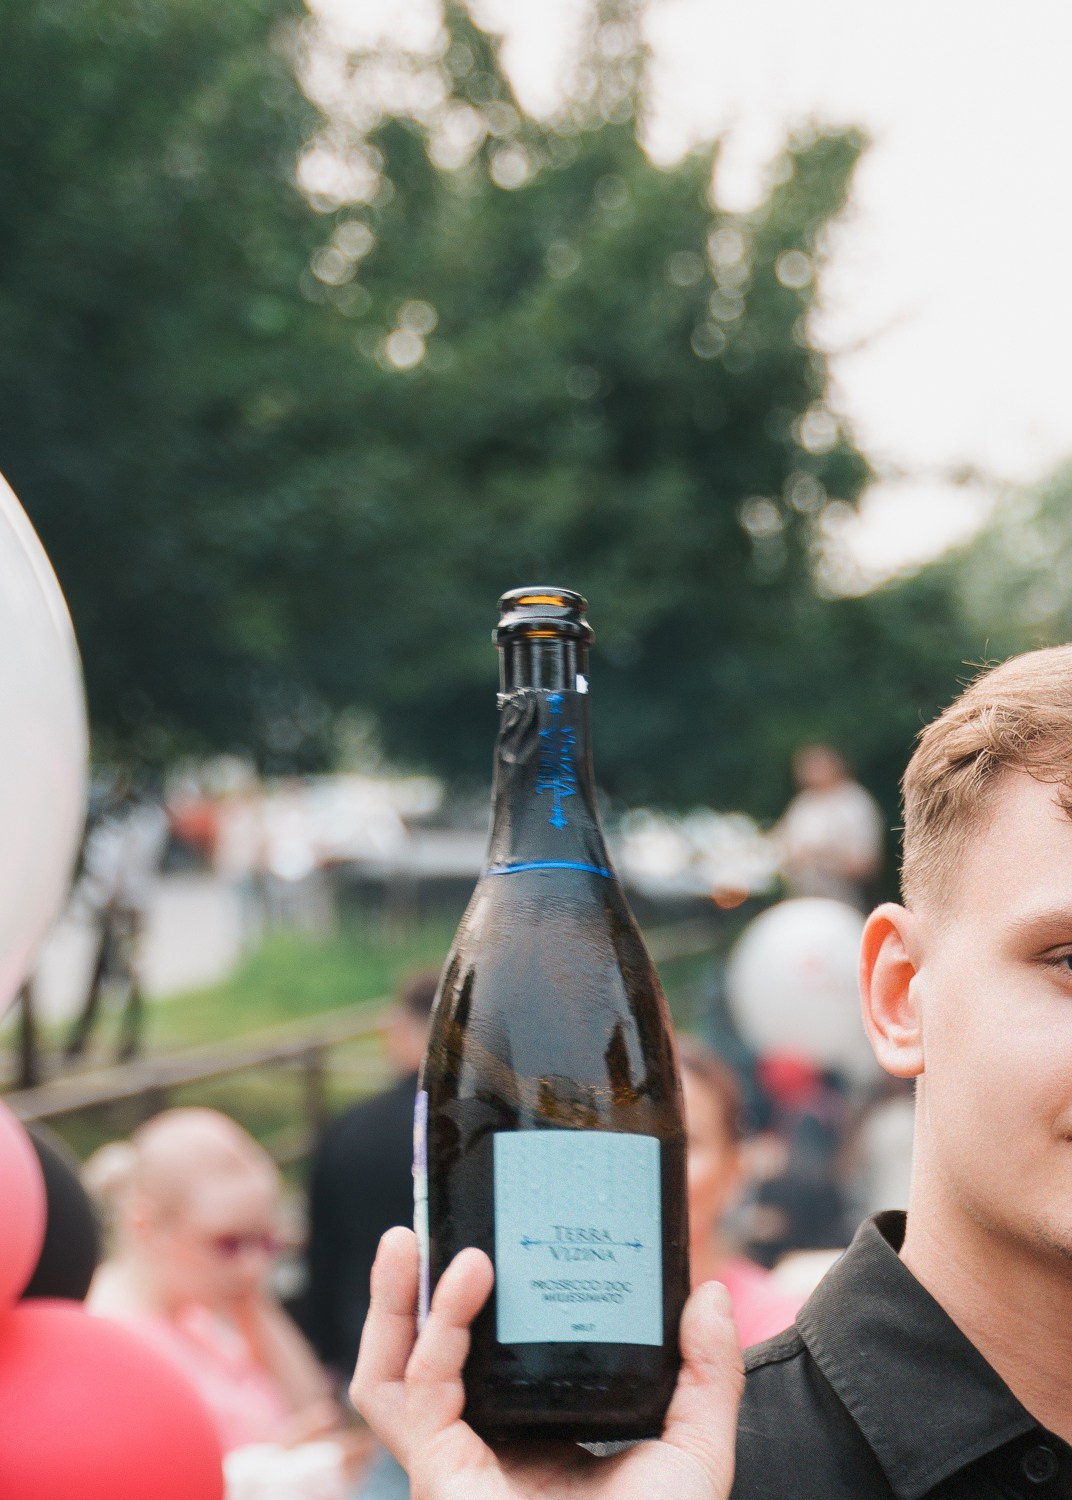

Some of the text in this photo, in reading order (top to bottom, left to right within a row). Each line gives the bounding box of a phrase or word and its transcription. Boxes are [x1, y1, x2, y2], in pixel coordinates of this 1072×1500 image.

[552, 1225, 614, 1241] TERRA
[549, 1246, 617, 1262] VIZINA
[531, 1279, 601, 1292] PROSECCO
